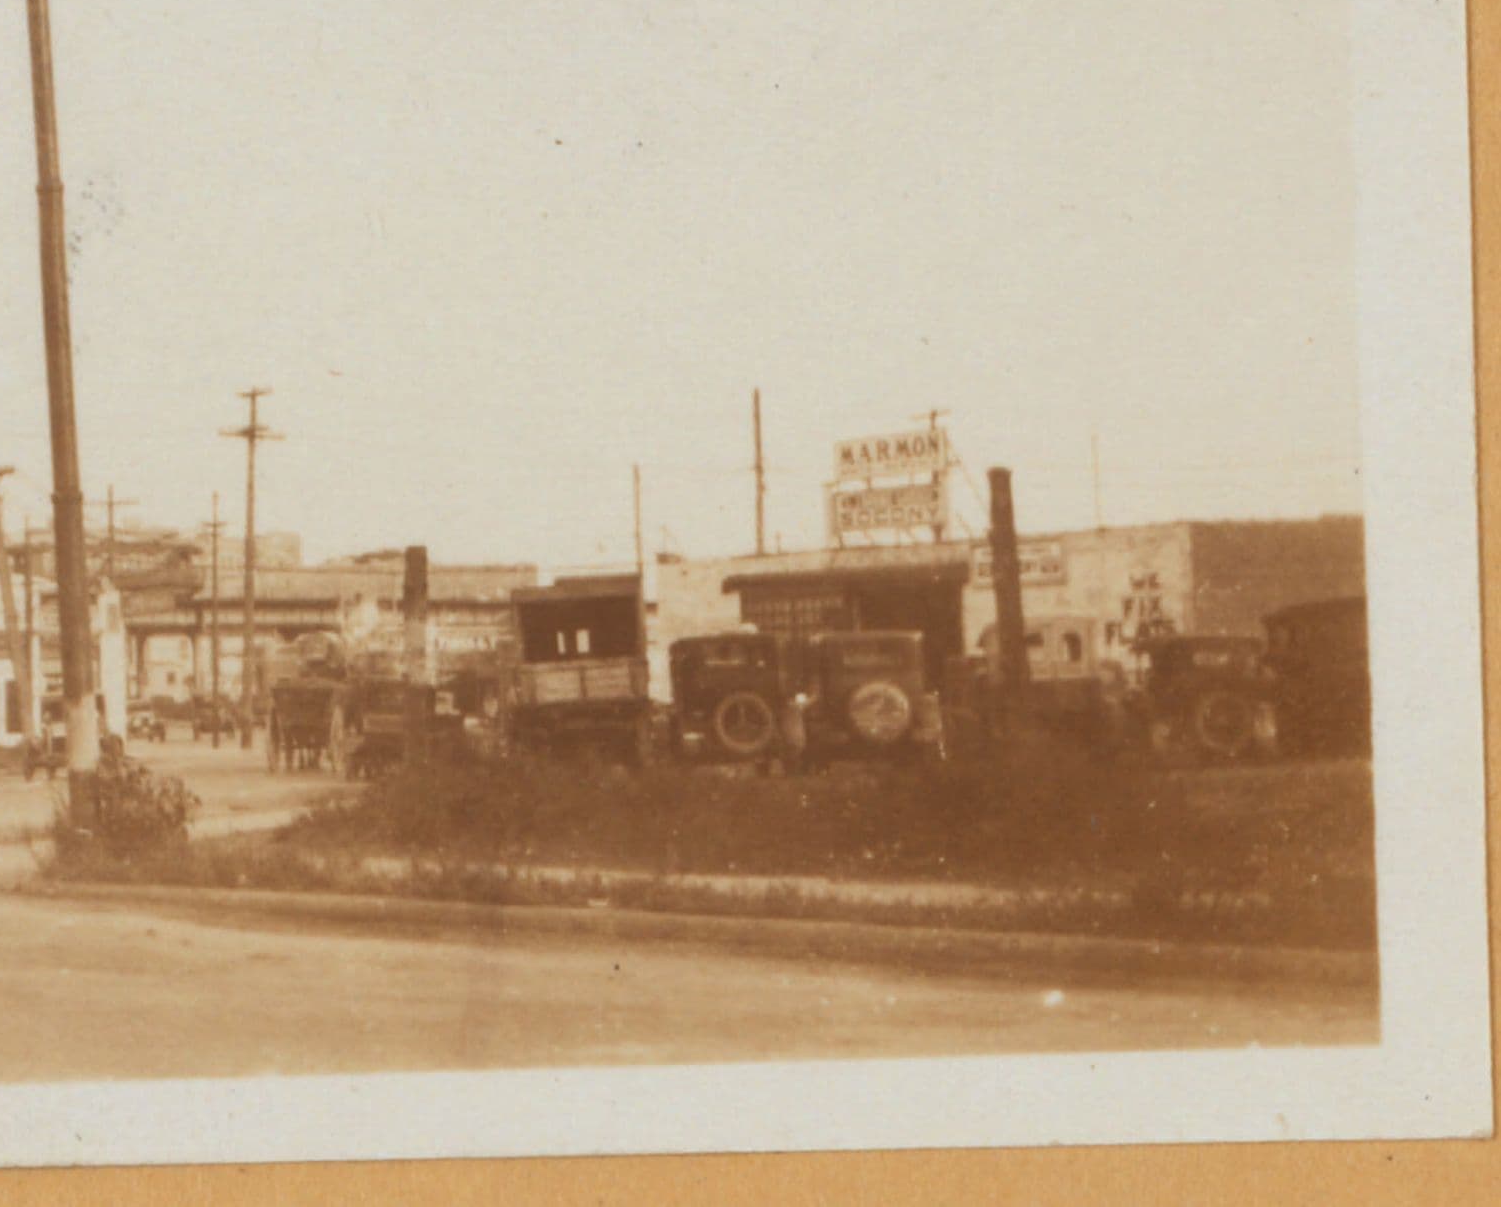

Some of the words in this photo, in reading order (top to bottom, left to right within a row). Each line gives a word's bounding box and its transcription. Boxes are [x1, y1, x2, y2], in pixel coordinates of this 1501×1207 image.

[840, 435, 940, 467] MARMON
[841, 504, 939, 528] SOCONY
[1130, 572, 1160, 591] WE
[1122, 596, 1163, 619] FIX
